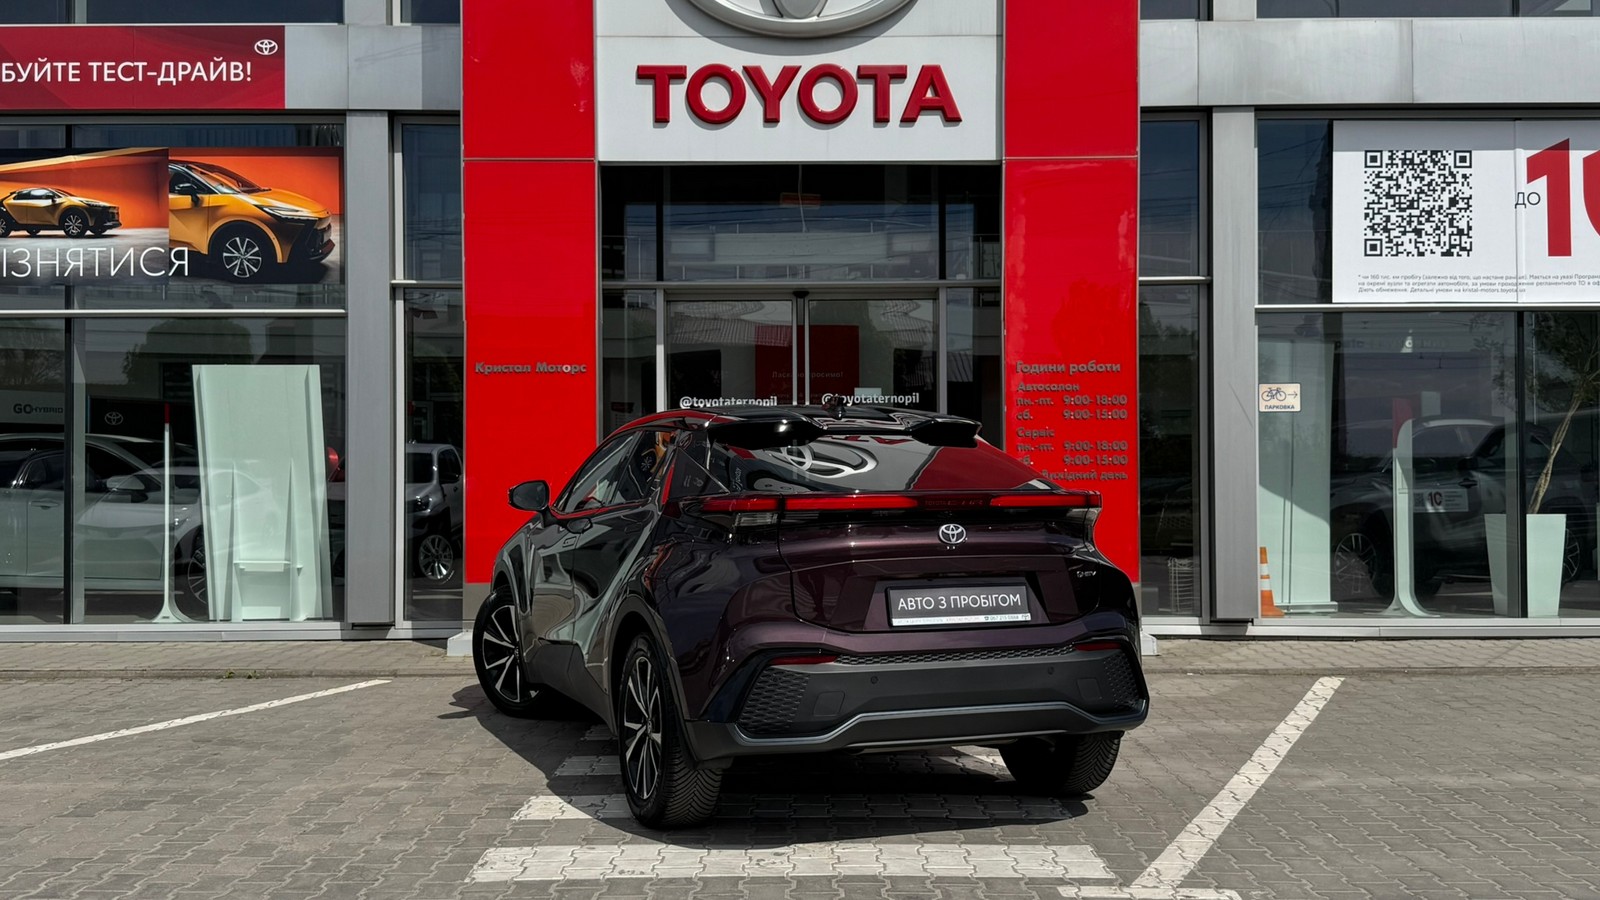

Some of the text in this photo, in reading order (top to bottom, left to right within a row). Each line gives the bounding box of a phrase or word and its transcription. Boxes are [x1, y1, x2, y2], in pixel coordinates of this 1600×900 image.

[1, 56, 252, 86] БУЙТЕ ТЕСТ-ДРАЙВ!
[636, 63, 963, 125] TOYOTA
[2, 246, 189, 278] ІЗНЯТИСЯ
[475, 361, 588, 375] Кристал Моторс
[1016, 360, 1121, 375] Години роботи
[1017, 382, 1080, 392] Автосалон
[821, 392, 920, 407] @oyotaternopil
[1016, 426, 1055, 439] Сервіс
[897, 596, 935, 611] АВТО
[950, 593, 1022, 609] ПРОБІГОМ
